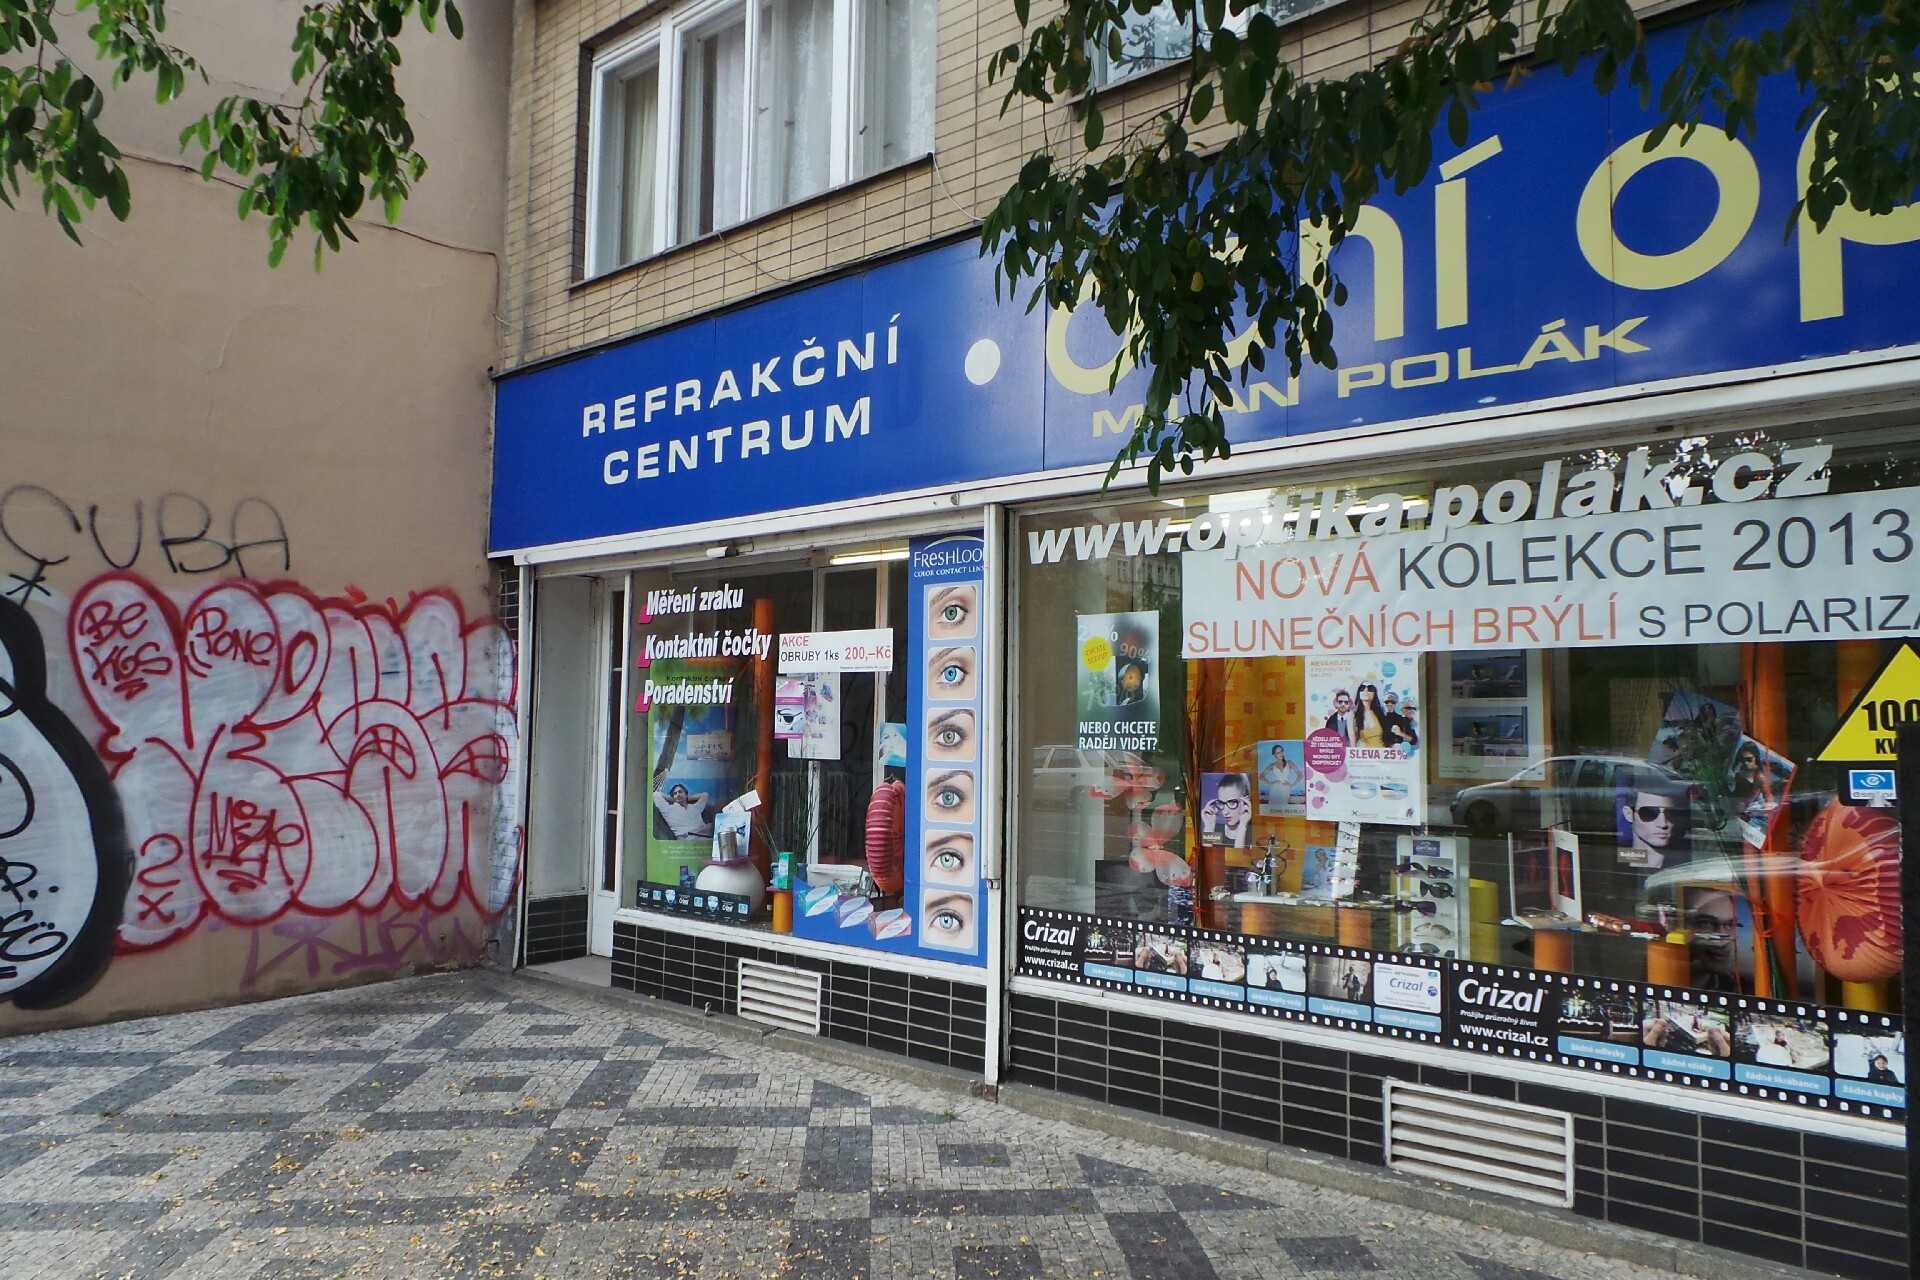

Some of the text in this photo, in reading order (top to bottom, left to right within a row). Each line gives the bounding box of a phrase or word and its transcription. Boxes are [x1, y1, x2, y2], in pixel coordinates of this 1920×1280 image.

[1338, 316, 1651, 398] POLÁK
[582, 313, 901, 437] REFRAKČNÍ
[603, 396, 871, 485] CENTRUM
[1028, 443, 1833, 564] www.optika-polak.cz
[1, 484, 290, 577] CUBA
[1237, 508, 1914, 601] NOVÁ KOLEKCE 2013
[914, 570, 935, 578] COLOR
[936, 566, 967, 576] CONTACT
[646, 583, 744, 616] Měření zraku
[1188, 592, 1920, 653] SLUNEČNÍCH BRÝLÍ S POLARIZ
[645, 628, 772, 660] Kontaktní čočky
[782, 636, 809, 647] AKCE
[781, 651, 821, 662] OBRUBY
[824, 650, 839, 661] 1ks
[643, 677, 734, 705] Poradenství
[1080, 721, 1156, 734] NEBO CHCETE
[1079, 734, 1158, 750] RADĚJI VIDĚT?
[1349, 749, 1380, 759] SLEVA
[1024, 920, 1077, 946] Crizal
[1024, 955, 1079, 971] www.crizal.cz
[1390, 978, 1424, 991] Crizal
[1458, 978, 1544, 1013] Crizal
[1460, 1024, 1549, 1047] www.crizal.cz
[1520, 1018, 1538, 1028] život
